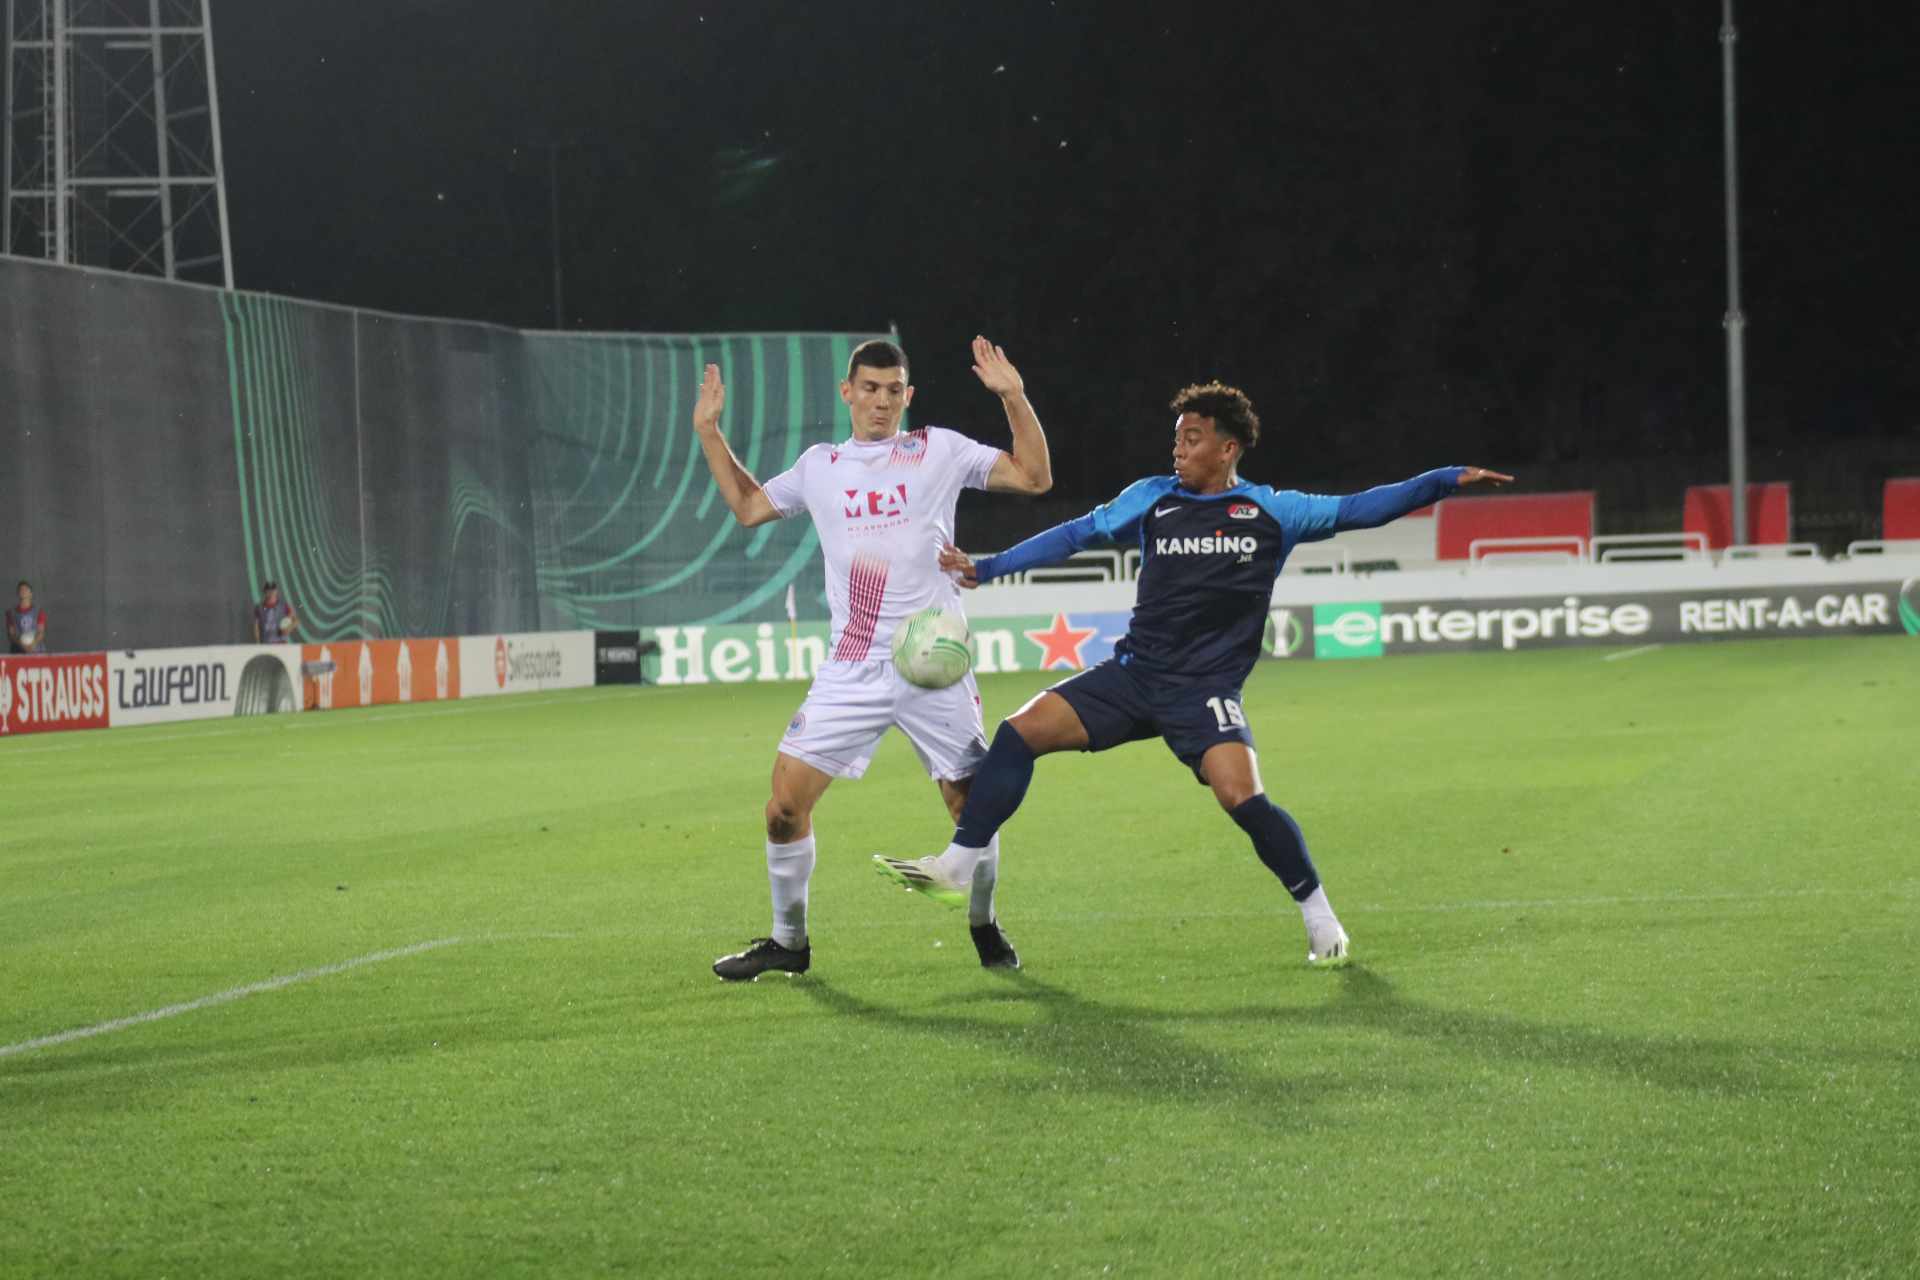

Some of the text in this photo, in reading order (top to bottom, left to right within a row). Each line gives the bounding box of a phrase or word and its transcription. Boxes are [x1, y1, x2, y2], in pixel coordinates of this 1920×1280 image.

[1314, 592, 1889, 649] enterprise RENT-A-CAR
[655, 623, 1021, 684] Heinn
[16, 664, 104, 723] STRAUSS
[114, 662, 231, 709] Laufenn
